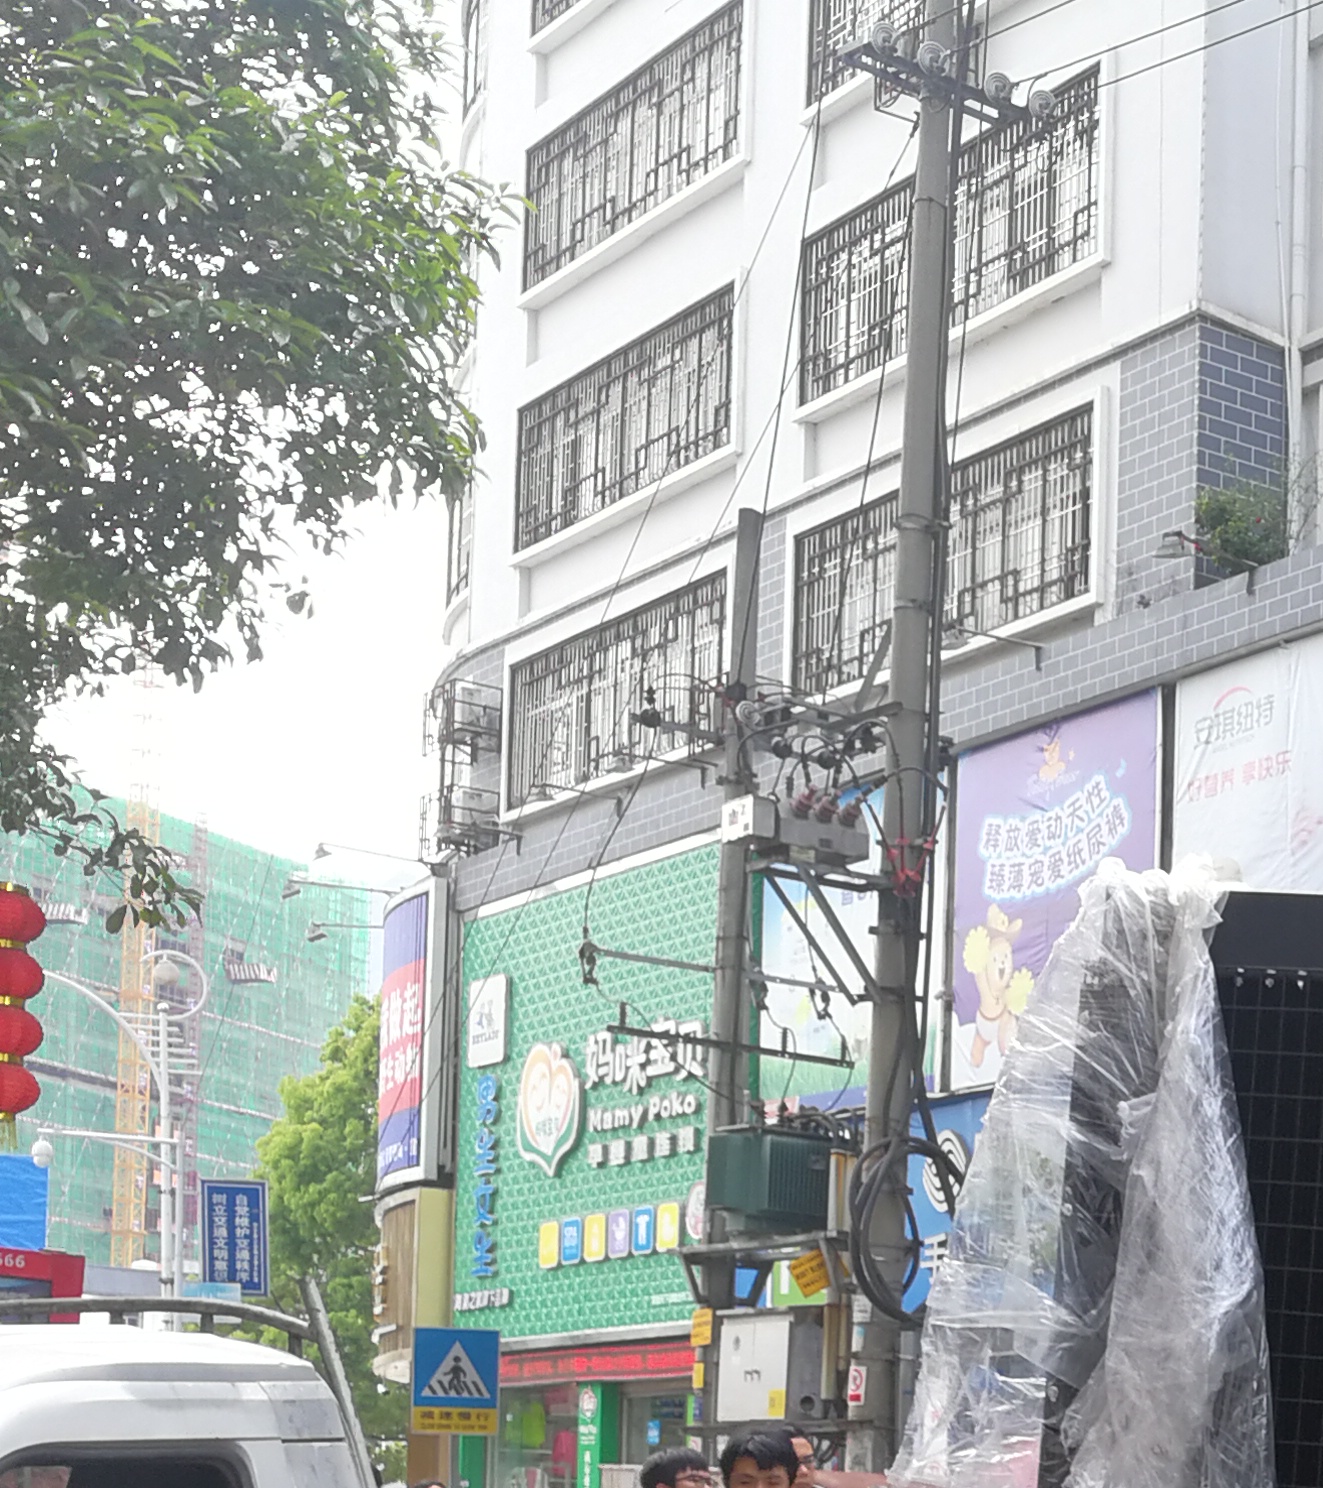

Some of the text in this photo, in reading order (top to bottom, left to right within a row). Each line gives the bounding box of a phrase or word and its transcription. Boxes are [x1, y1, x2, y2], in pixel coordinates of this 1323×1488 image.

[983, 779, 1108, 853] 释放爱动天性
[584, 1016, 706, 1096] 妈咪宝贝
[587, 1104, 644, 1133] Mamy
[648, 1091, 697, 1122] Poko
